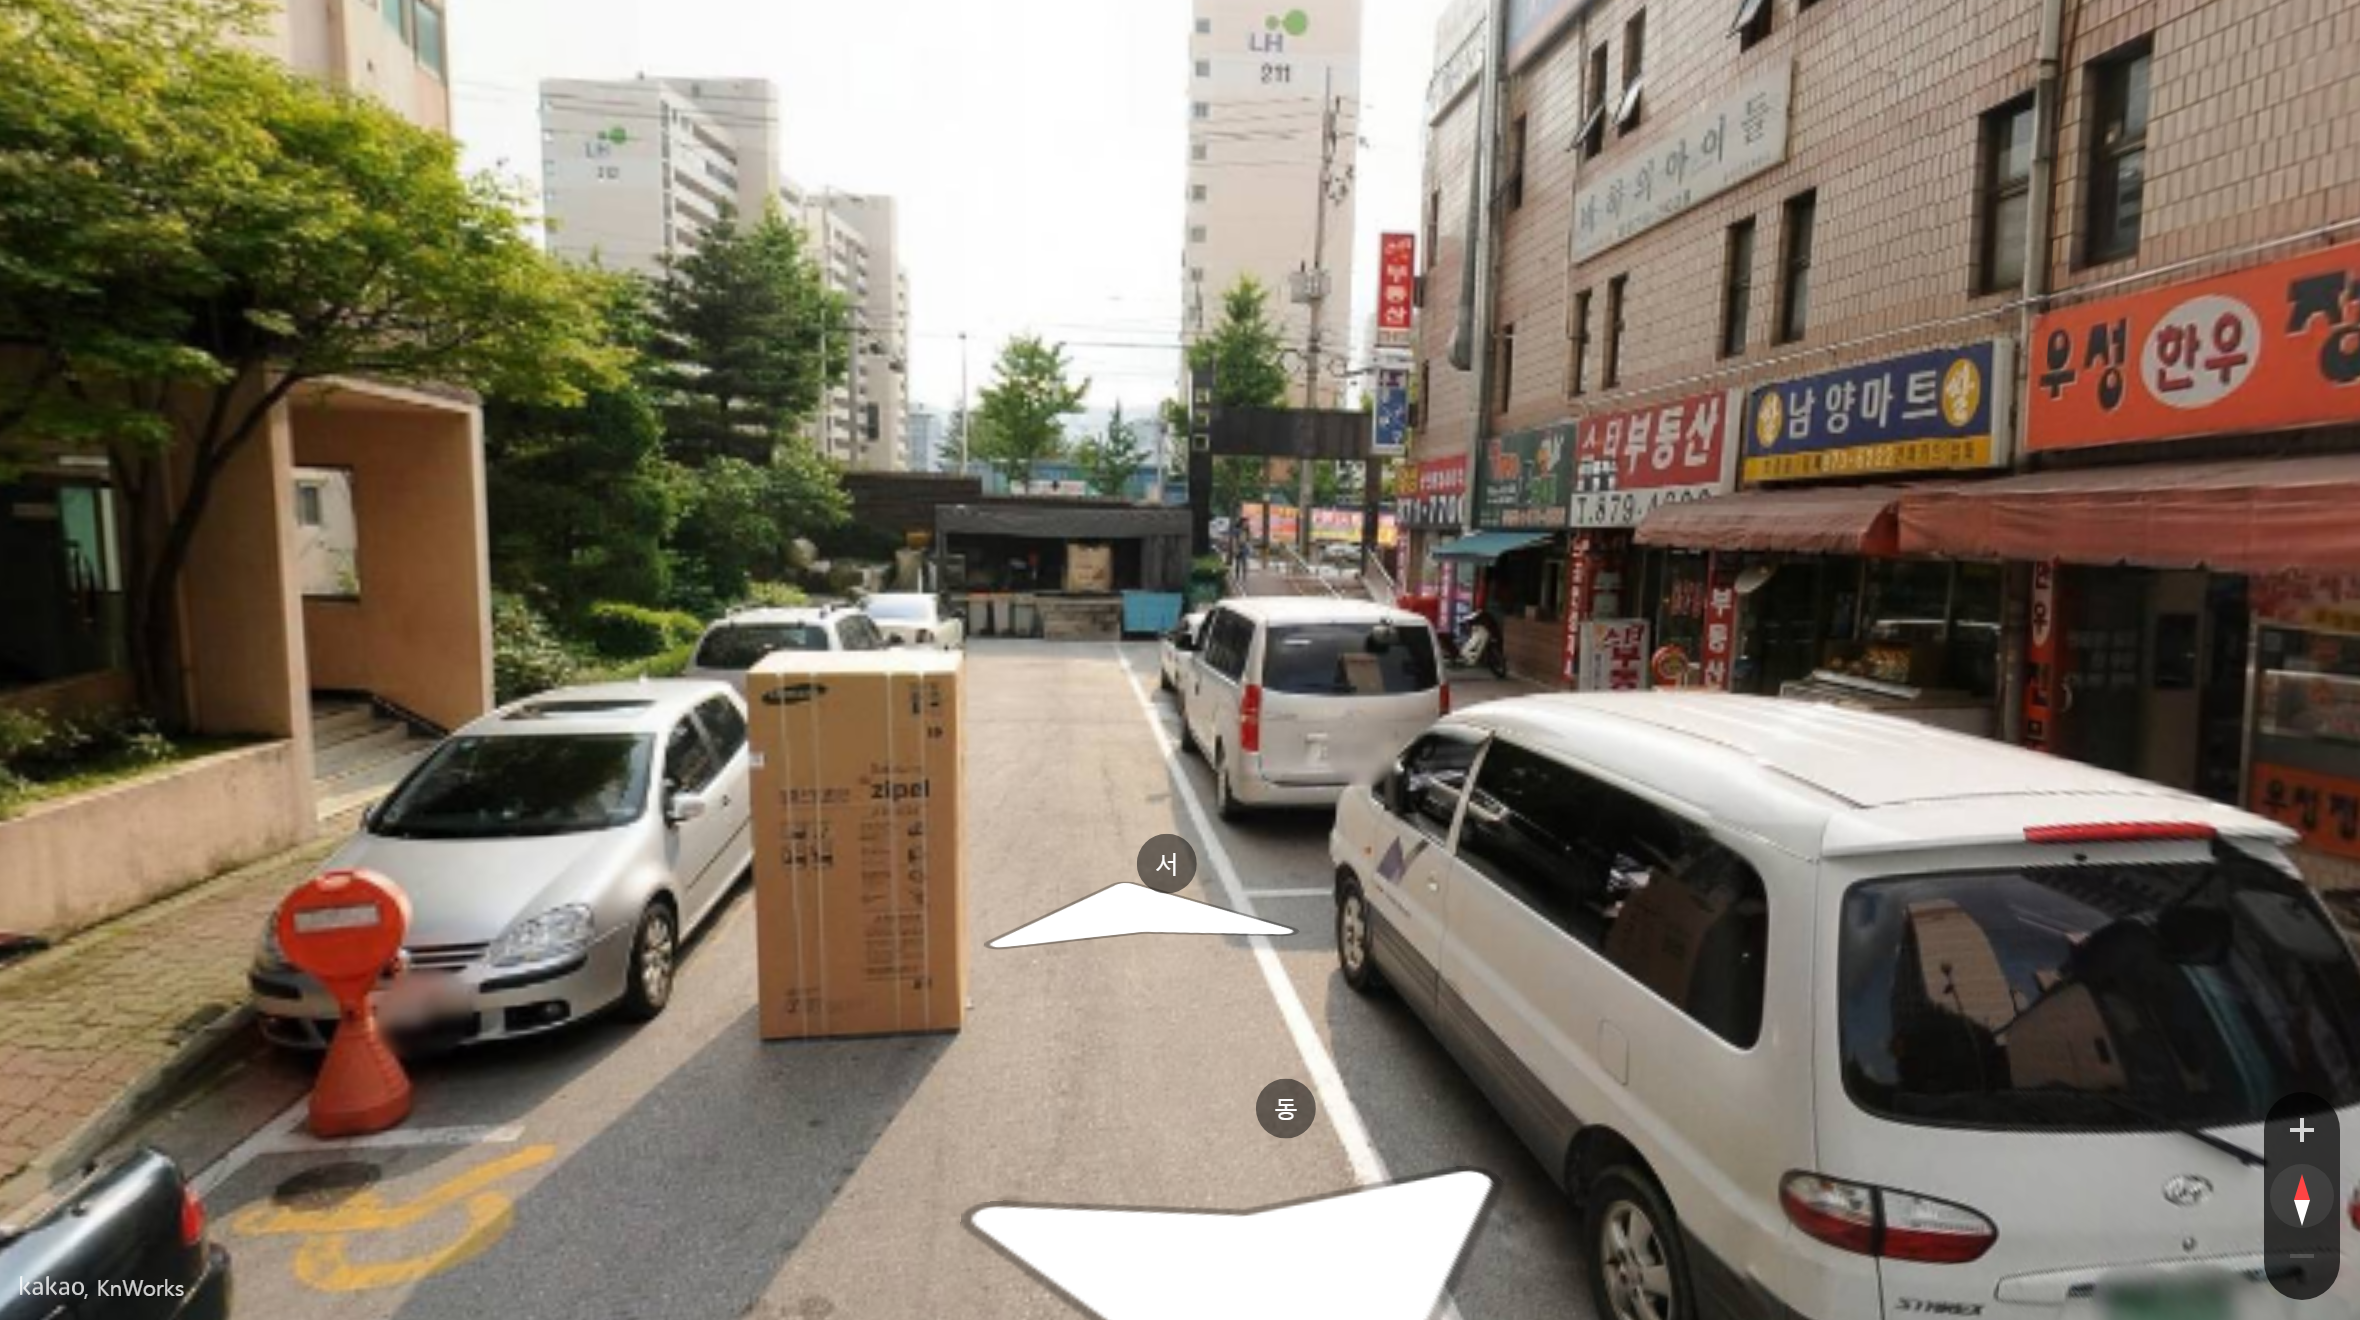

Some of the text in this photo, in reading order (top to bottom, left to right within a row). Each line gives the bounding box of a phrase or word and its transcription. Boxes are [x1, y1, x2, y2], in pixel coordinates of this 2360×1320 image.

[1249, 33, 1284, 52] LH
[1260, 63, 1291, 83] 211
[2039, 317, 2130, 411] 우성
[2156, 312, 2249, 394] 한우
[1787, 370, 1938, 440] 남양마트
[870, 778, 931, 802] zipel
